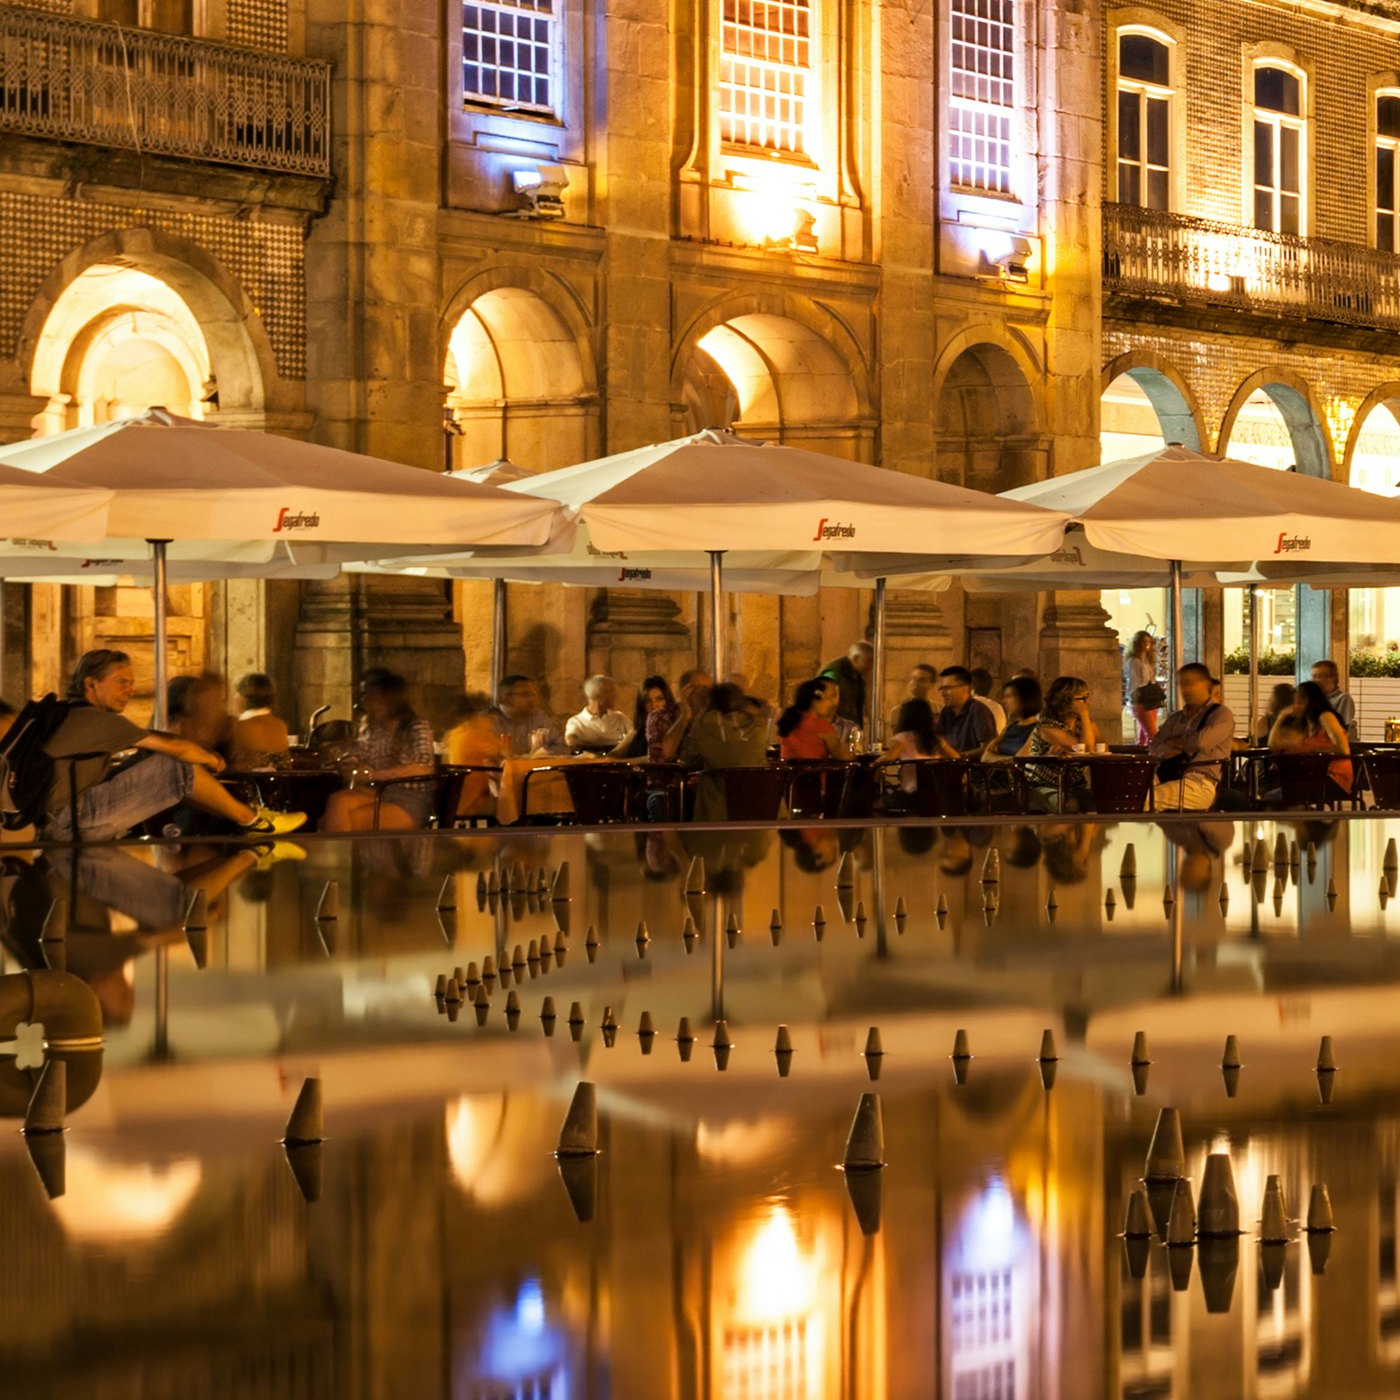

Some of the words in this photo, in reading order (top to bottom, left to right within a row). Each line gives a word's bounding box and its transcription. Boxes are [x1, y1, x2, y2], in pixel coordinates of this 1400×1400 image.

[272, 507, 320, 532] Segafredo
[813, 518, 856, 541] Segafredo
[1273, 532, 1312, 554] Segafredo
